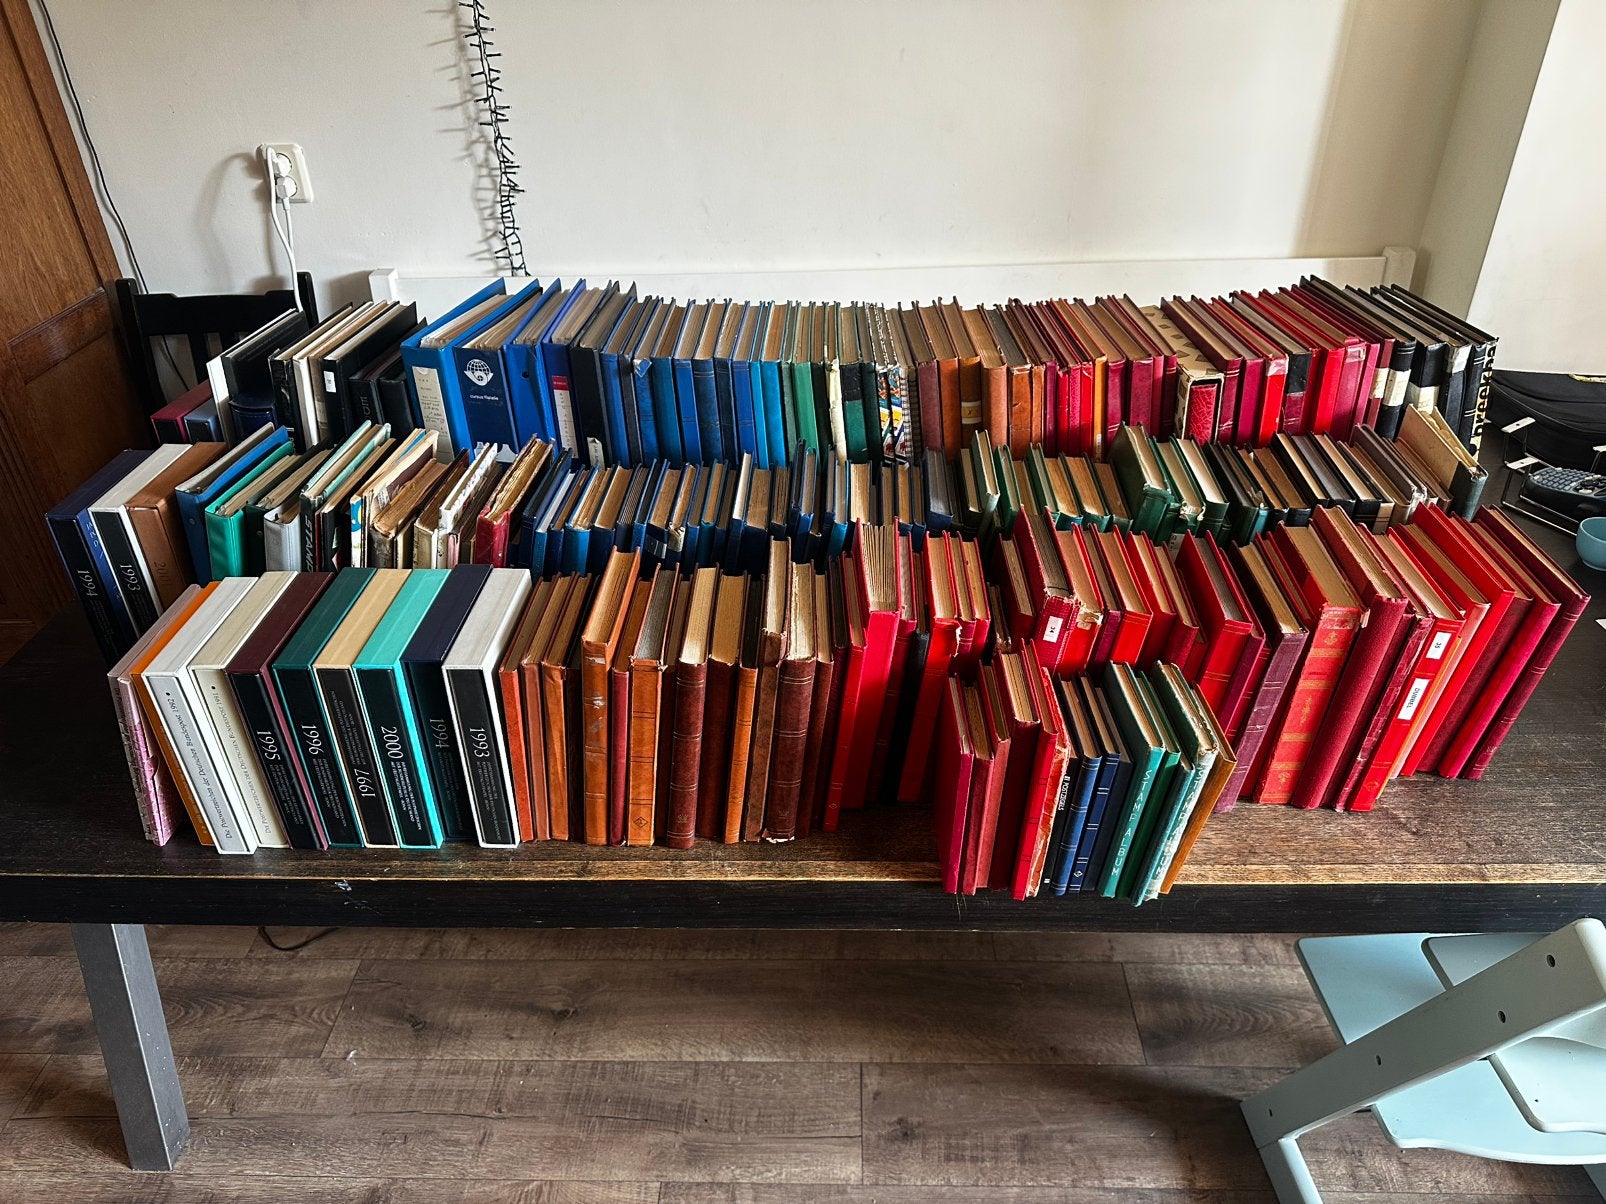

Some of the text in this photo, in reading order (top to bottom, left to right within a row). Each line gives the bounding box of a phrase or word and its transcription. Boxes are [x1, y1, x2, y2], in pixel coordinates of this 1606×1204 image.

[77, 569, 98, 597] 1994
[120, 564, 140, 591] 1993
[256, 731, 281, 761] 1995
[301, 724, 324, 755] 1996
[381, 726, 404, 759] 2000
[430, 718, 449, 749] 1994
[469, 727, 490, 758] 1993
[201, 776, 211, 787] der
[354, 768, 376, 798] 1997
[1111, 769, 1152, 876] STAMP ALBUM
